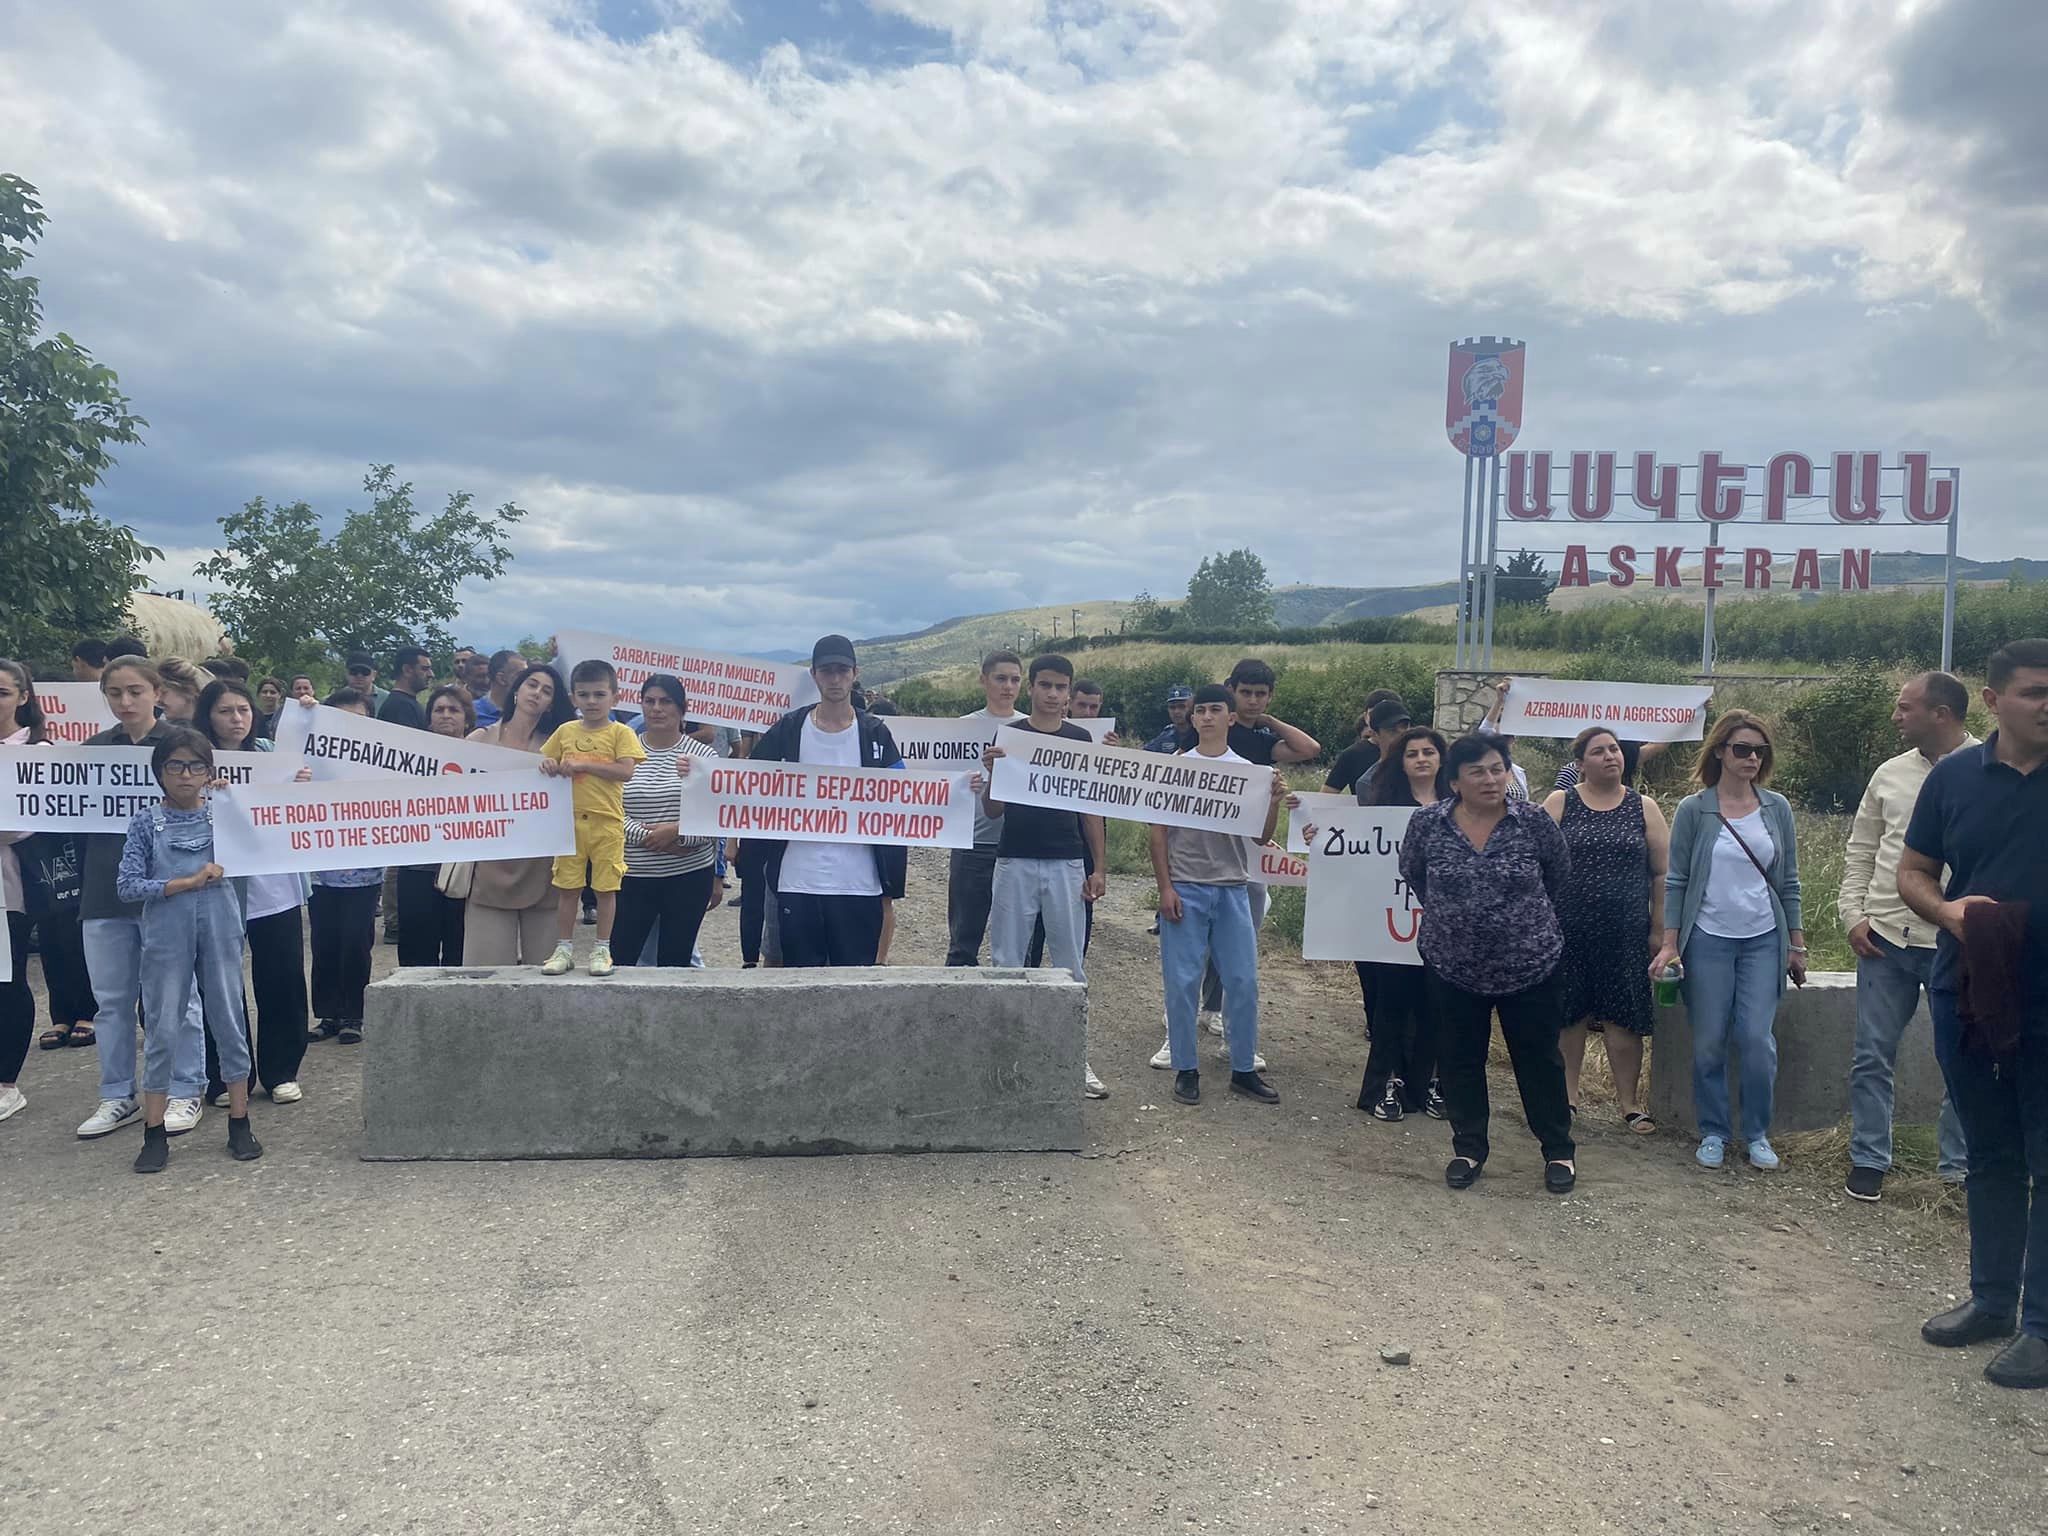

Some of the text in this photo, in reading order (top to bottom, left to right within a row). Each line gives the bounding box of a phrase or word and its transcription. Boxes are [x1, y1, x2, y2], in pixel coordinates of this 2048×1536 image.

[1503, 450, 1955, 524] ԱՍԿԵՐԱՆ
[1560, 544, 1873, 591] ASKERAN
[612, 646, 776, 687] ЗАЯВЛЕНИЕ ШАРЛЯ МИШЕЛЯ
[685, 698, 746, 722] ЕНИЗАЦИИ
[717, 682, 791, 709] ПОДДЕРЖКА
[1524, 701, 1589, 719] AZERBAIJAN
[1591, 704, 1602, 721] IS
[1604, 705, 1621, 721] AN
[303, 733, 439, 777] АЗЕРБАЙДЖАН
[901, 741, 931, 760] LAW
[933, 741, 979, 760] COMES
[16, 761, 45, 785] WE
[50, 762, 105, 787] DON'T
[110, 763, 154, 787] SELL
[710, 768, 949, 806] ОТКРОЙТЕ БЕРДЗОРСКИЙ
[1029, 747, 1249, 796] ДОРОГА ЧЕРЕЗ АГДАМ ВЕДЕТ
[16, 794, 40, 816] TO
[45, 794, 97, 817] SELF-
[1028, 772, 1038, 793] К
[1042, 775, 1142, 806] ОЧЕРЕДНОМУ
[251, 791, 549, 826] THE ROAD THROUGH AGHDAM WILL LEAD
[718, 805, 944, 839] (ЛАЧИНСКИЙ) КОРИДОР
[291, 831, 312, 850] US
[314, 829, 335, 849] TO
[338, 827, 367, 847] THE
[372, 824, 431, 845] SECOND
